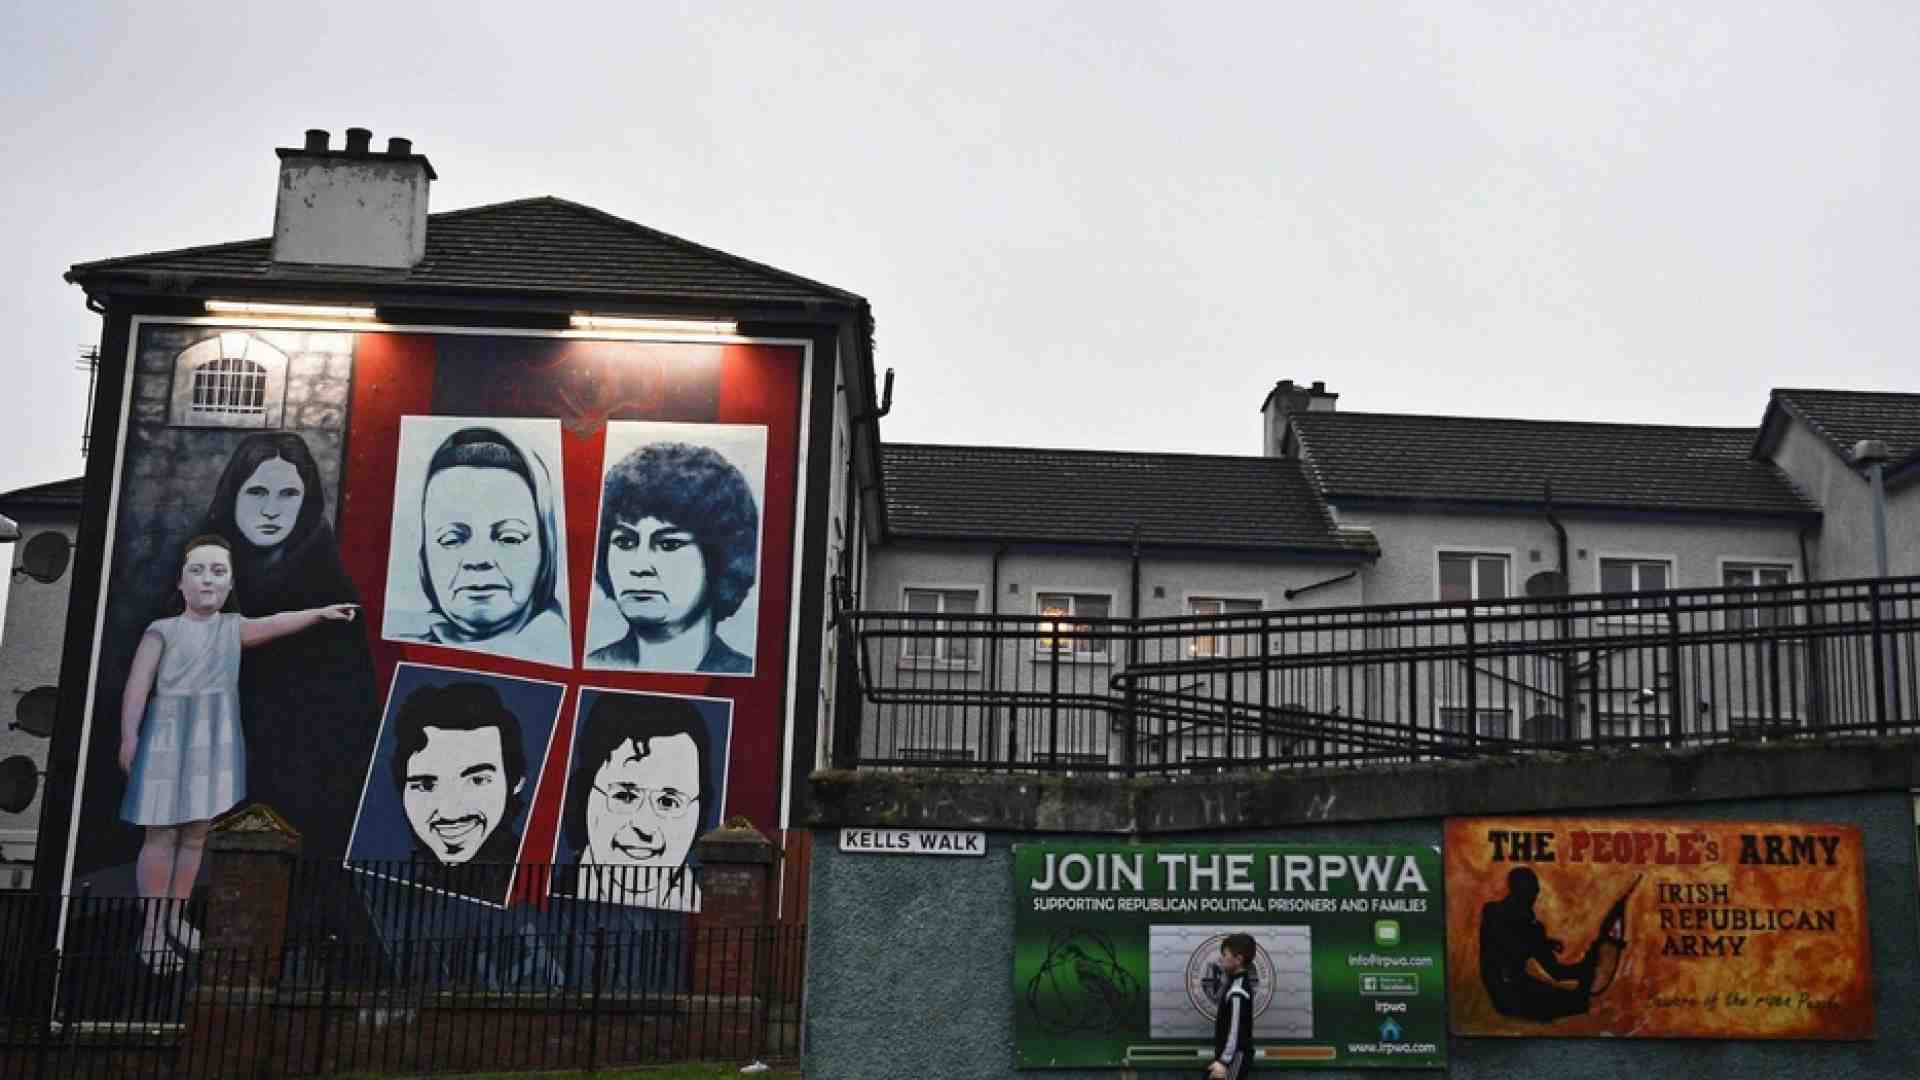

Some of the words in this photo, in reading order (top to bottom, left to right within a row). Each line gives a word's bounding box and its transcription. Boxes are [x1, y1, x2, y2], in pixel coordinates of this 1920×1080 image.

[846, 831, 910, 848] KELLS
[919, 834, 977, 850] WALK
[1489, 829, 1556, 862] THE
[1570, 831, 1720, 864] PEOPLE's
[1738, 834, 1841, 867] ARMY
[1031, 853, 1144, 892] JOIN
[1158, 853, 1256, 892] THE
[1269, 854, 1429, 893] IRPWA
[1658, 883, 1729, 902] IRISH
[1033, 897, 1115, 911] SUPPORTING
[1118, 897, 1198, 911] REPUBLICAN
[1201, 898, 1265, 912] POLITICAL
[1268, 898, 1337, 912] PRISONERS
[1340, 899, 1369, 912] AND
[1371, 899, 1427, 912] FAMILIES
[1660, 908, 1836, 931] REPUBLICAN
[1661, 935, 1747, 957] ARMY
[1348, 1042, 1436, 1055] www.irpwa.com
